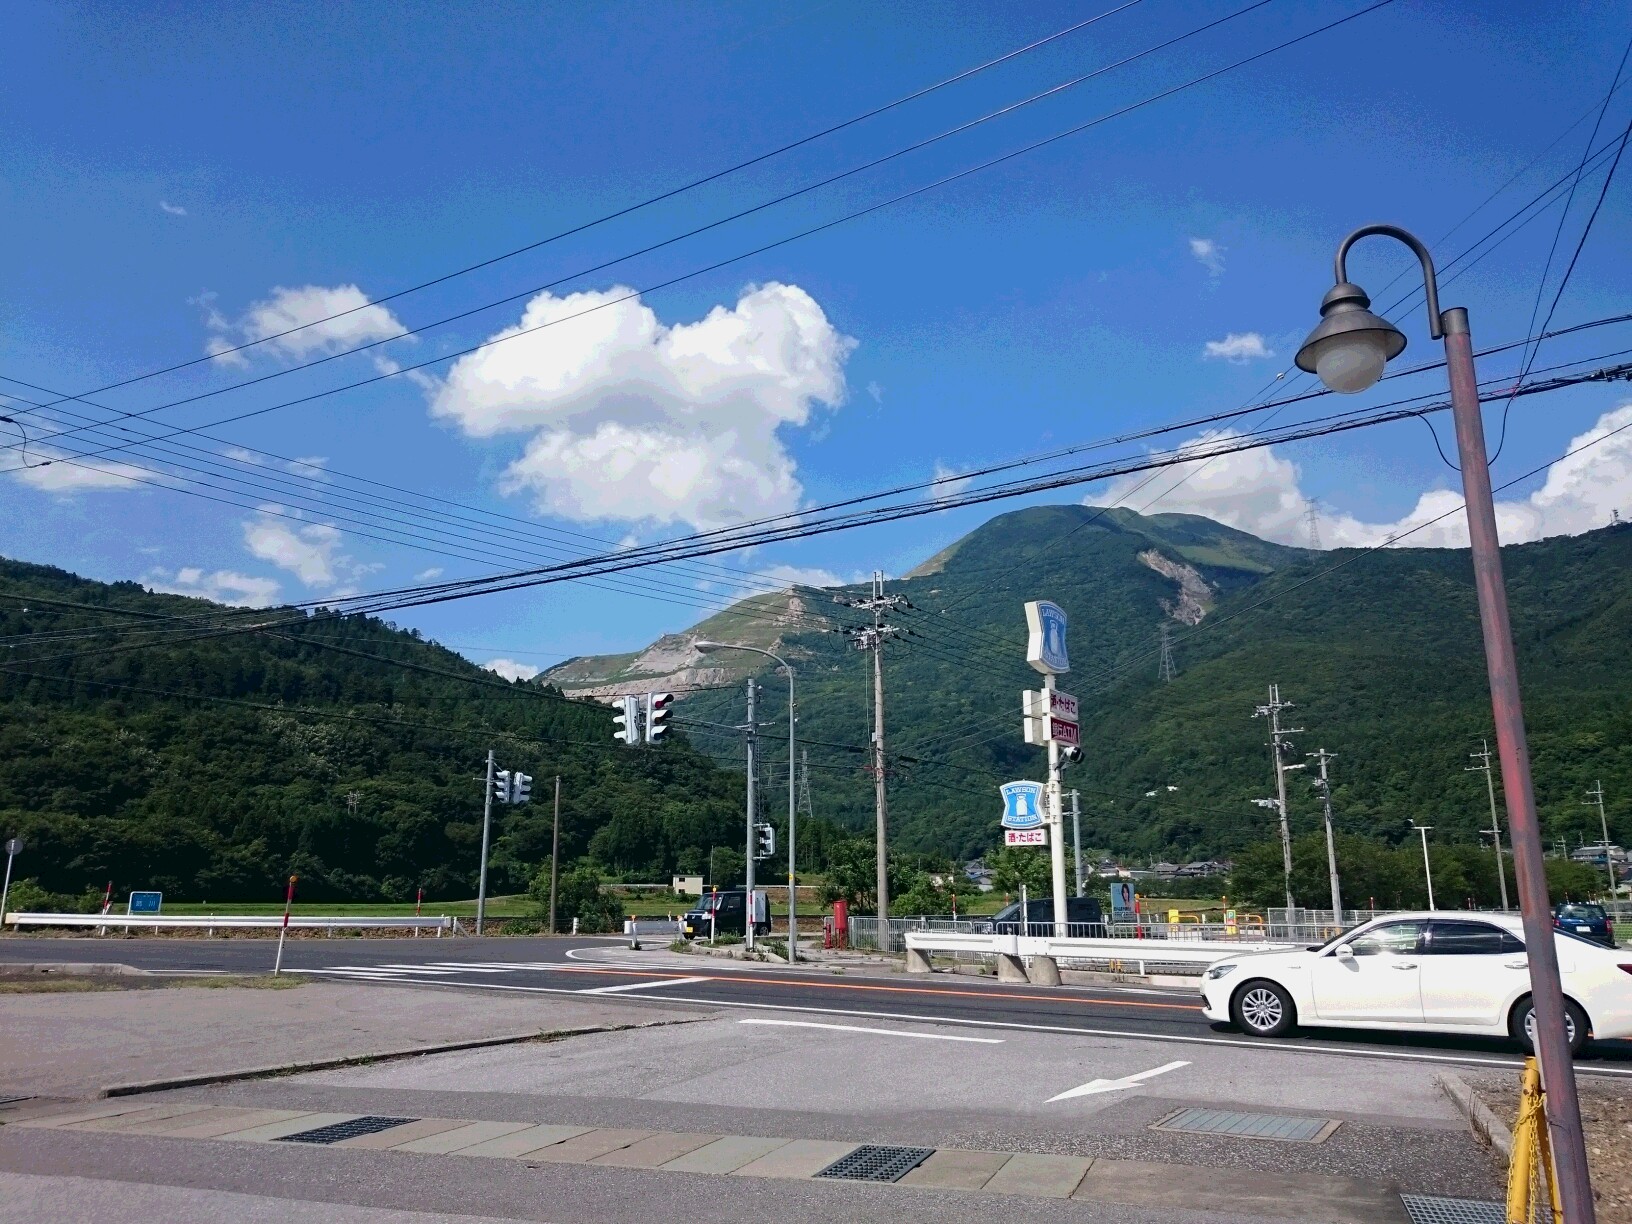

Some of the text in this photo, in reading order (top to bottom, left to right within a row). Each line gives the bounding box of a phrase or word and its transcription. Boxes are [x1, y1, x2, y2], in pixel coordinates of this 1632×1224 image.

[1042, 608, 1065, 625] LAWSON
[1005, 786, 1037, 796] LAWSON
[1007, 814, 1038, 823] STATION
